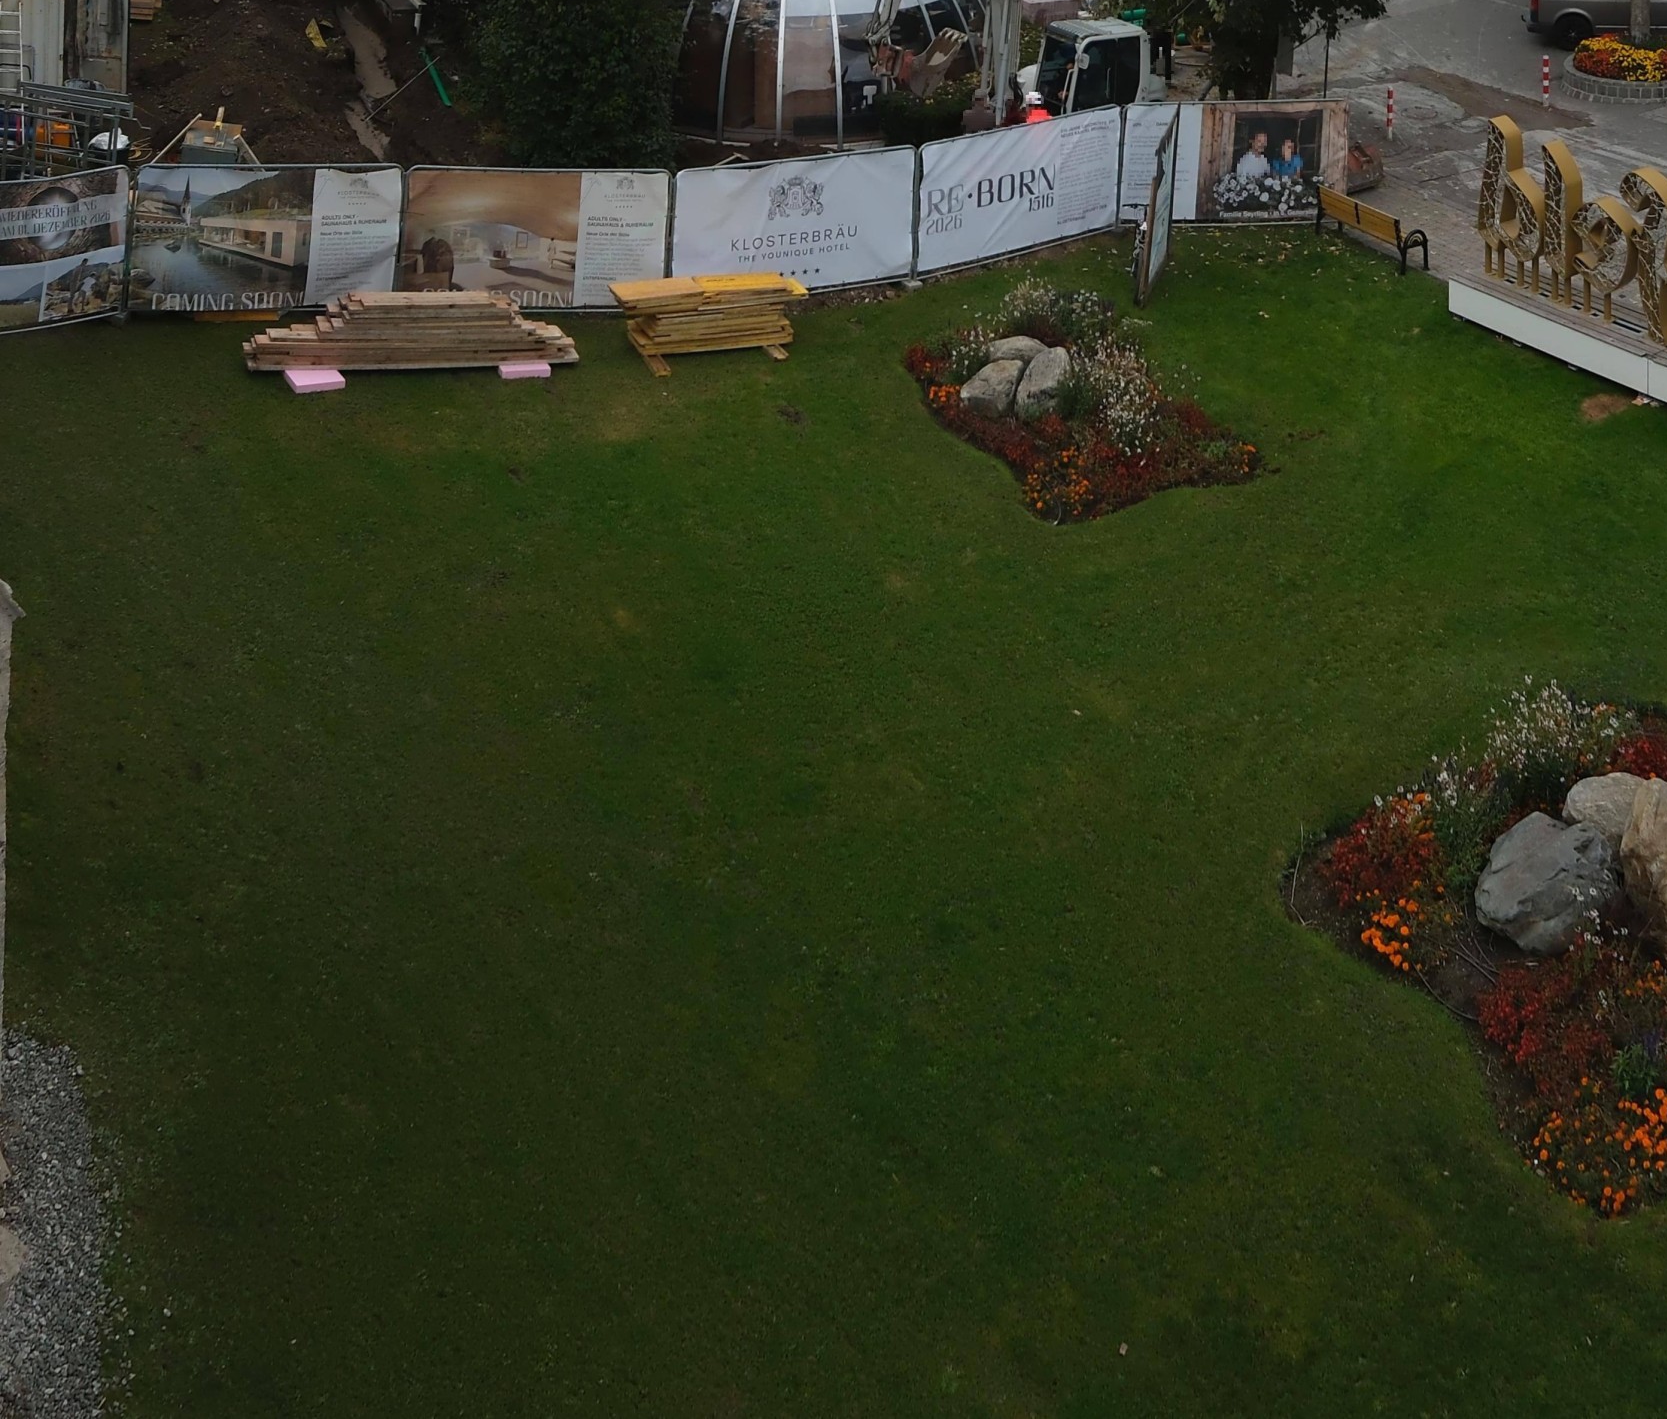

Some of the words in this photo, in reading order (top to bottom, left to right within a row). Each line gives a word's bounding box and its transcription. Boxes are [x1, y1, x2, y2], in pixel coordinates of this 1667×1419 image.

[1028, 192, 1055, 213] 1516
[926, 213, 963, 236] 2026
[731, 224, 858, 252] KLOSTERBRÄU
[738, 254, 757, 264] THE
[761, 247, 815, 261] YOUNIQUE
[818, 242, 851, 253] HOTEL
